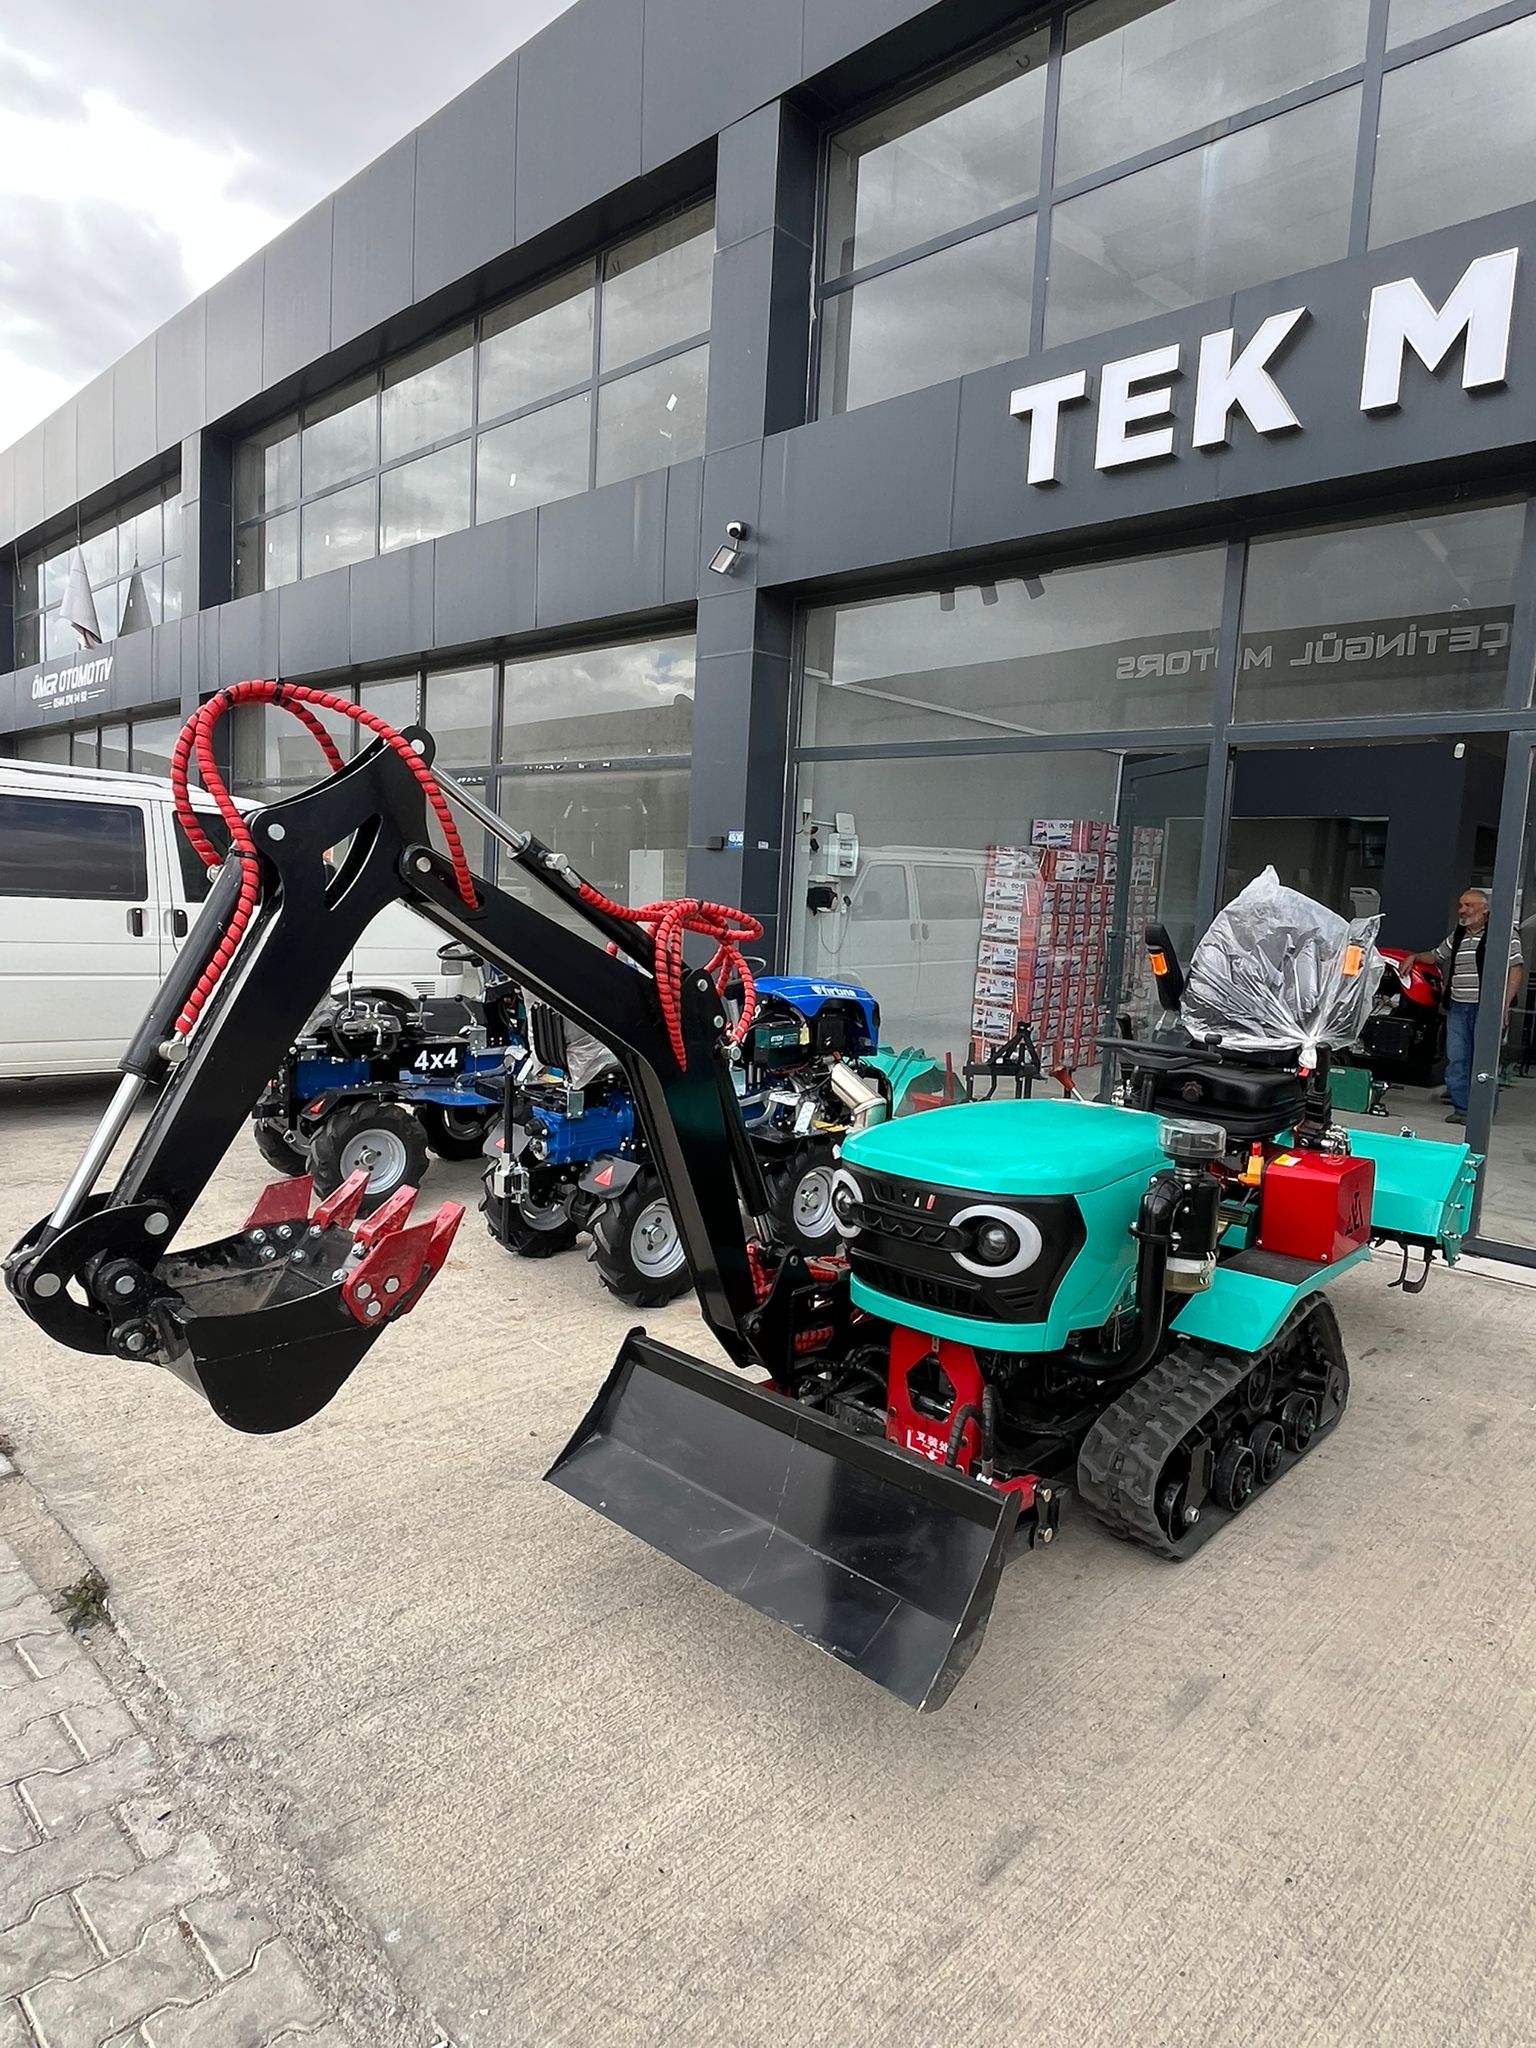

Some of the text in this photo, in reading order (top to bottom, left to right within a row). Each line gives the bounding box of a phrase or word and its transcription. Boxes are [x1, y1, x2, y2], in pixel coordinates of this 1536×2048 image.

[1009, 247, 1519, 486] TEK M
[414, 1047, 458, 1071] 4x4
